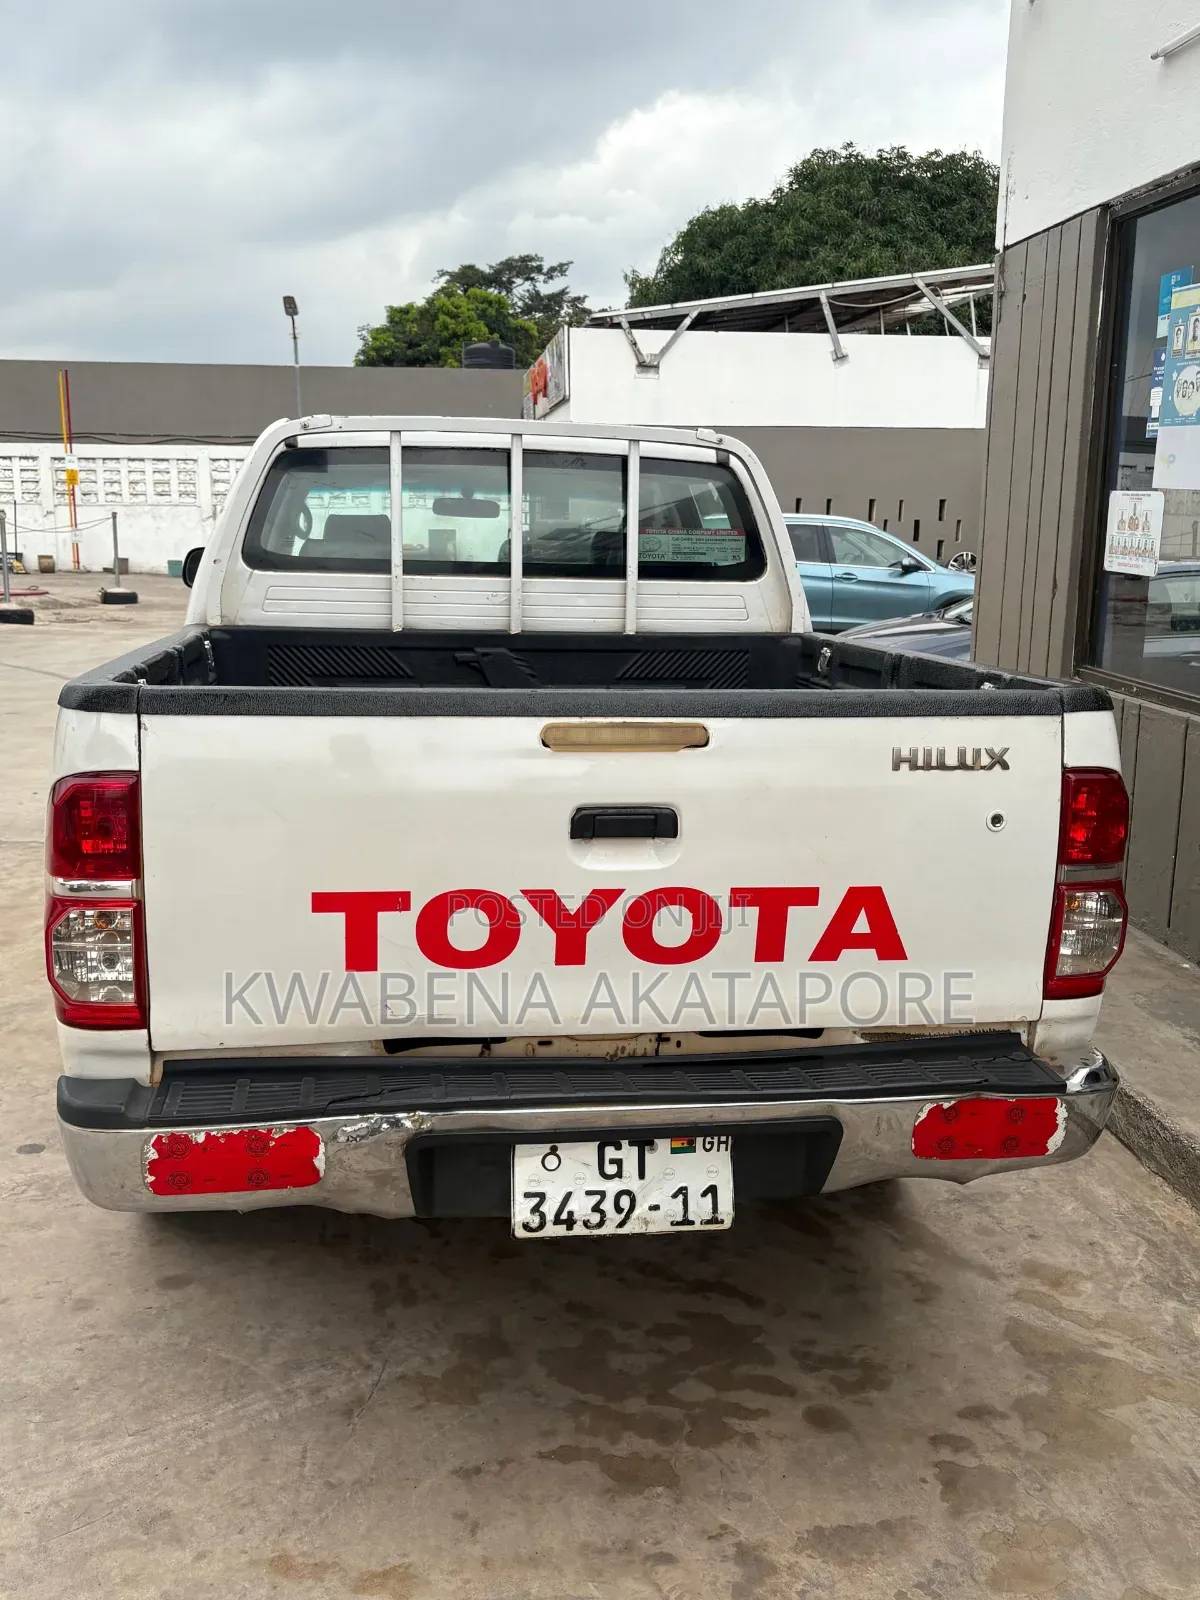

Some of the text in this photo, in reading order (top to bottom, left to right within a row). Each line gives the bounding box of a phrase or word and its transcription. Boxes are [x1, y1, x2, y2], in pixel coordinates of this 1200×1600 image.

[638, 552, 665, 560] TOYOTA
[891, 746, 1010, 771] HILUX
[311, 886, 909, 973] TOYOTA
[702, 1136, 729, 1153] GH
[597, 1138, 655, 1181] GT
